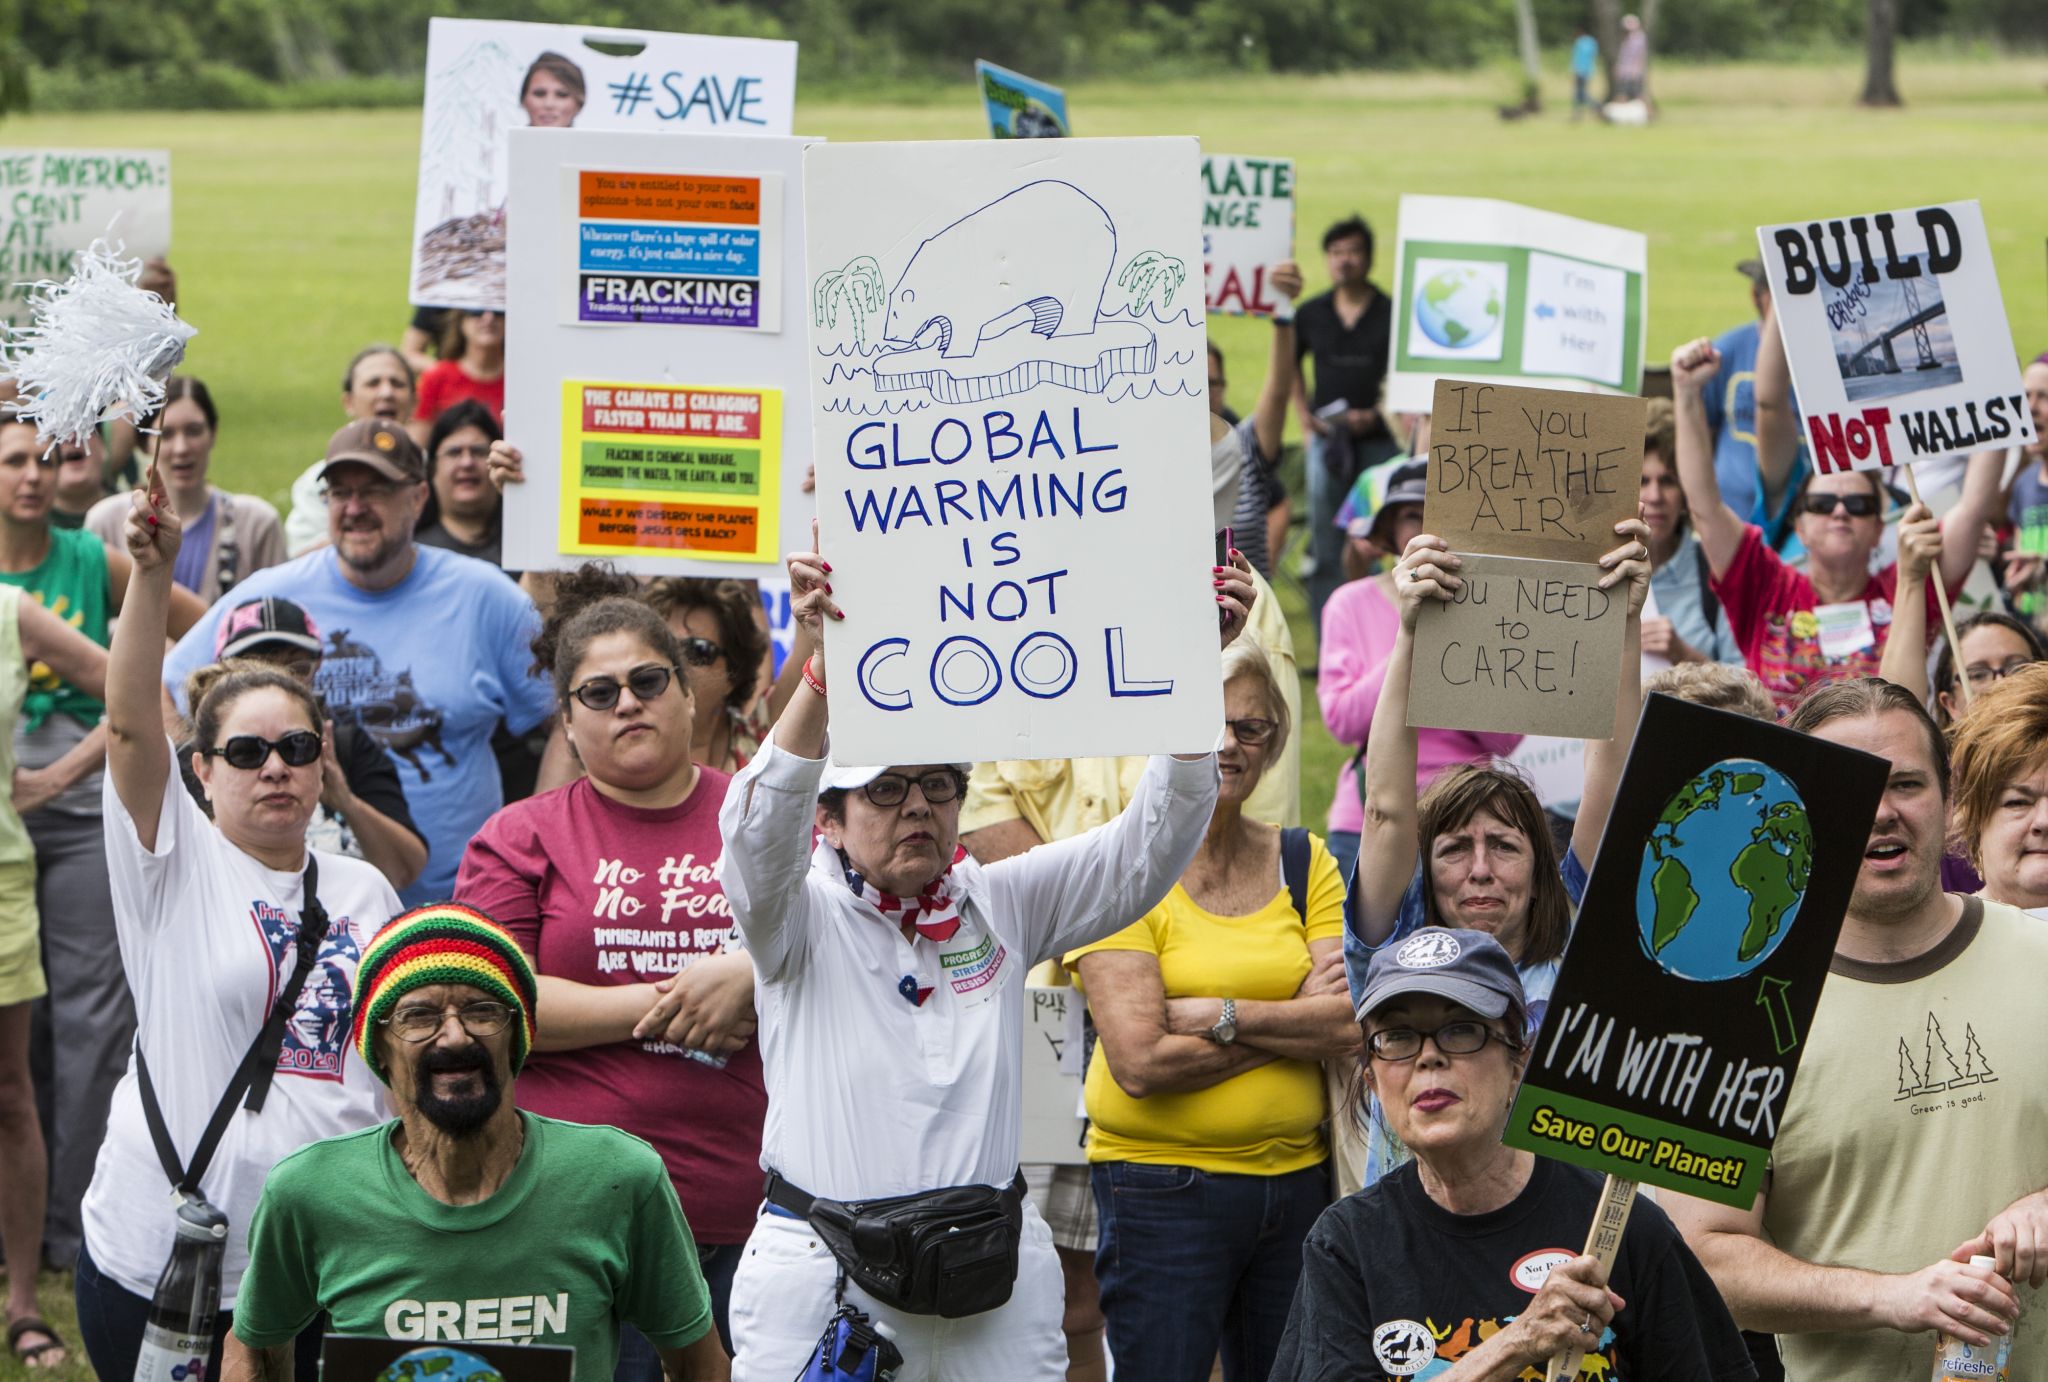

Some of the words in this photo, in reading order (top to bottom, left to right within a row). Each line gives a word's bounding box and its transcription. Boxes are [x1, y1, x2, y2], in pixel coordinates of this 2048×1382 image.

[608, 71, 767, 125] #SAVE
[596, 177, 616, 190] You
[619, 179, 636, 190] are
[640, 179, 679, 192] entitled
[683, 181, 695, 192] to
[697, 183, 721, 195] your
[725, 184, 747, 194] own
[656, 197, 673, 208] not
[676, 199, 701, 211] your
[704, 200, 726, 210] own
[730, 199, 756, 211] facts
[582, 226, 629, 243] Whenever
[631, 229, 663, 244] there's
[664, 234, 671, 244] a
[699, 232, 718, 247] spill
[719, 233, 731, 246] of
[732, 235, 756, 247] solar
[1775, 207, 1962, 294] BUILD
[628, 246, 643, 259] it's
[643, 247, 663, 261] just
[664, 247, 693, 261] called
[694, 251, 701, 261] a
[703, 250, 723, 262] nice
[587, 277, 753, 307] FRACKING
[588, 302, 628, 315] Trading
[629, 303, 659, 314] clean
[661, 304, 691, 315] water
[693, 305, 709, 316] for
[711, 306, 735, 319] dirty
[737, 307, 751, 318] oil
[1562, 305, 1607, 325] with
[1561, 331, 1597, 352] Her
[584, 389, 612, 406] THE
[615, 390, 670, 409] CLIMATE
[673, 392, 687, 410] IS
[689, 394, 759, 414] CHANGING
[594, 409, 645, 427] FASTER
[648, 411, 686, 429] THAN
[689, 413, 713, 430] WE
[715, 414, 748, 432] ARE.
[1808, 407, 1894, 474] NOT
[1900, 395, 2029, 455] WALLS!
[847, 407, 1119, 470] GLOBAL
[605, 447, 644, 462] FRACKING
[646, 450, 654, 463] IS
[656, 450, 695, 465] CHEMICAL
[1433, 444, 1626, 498] BREATHE
[584, 464, 624, 479] POISONING
[626, 466, 641, 480] THE
[674, 468, 688, 482] THE
[721, 471, 737, 484] AND
[844, 468, 1128, 534] WARMING
[1471, 493, 1586, 540] AIR,
[963, 532, 1021, 568] IS
[940, 569, 1068, 622] NOT
[1443, 577, 1488, 612] OU
[1516, 578, 1610, 621] NEED
[1495, 616, 1530, 640] to
[857, 627, 1175, 712] COOL
[1441, 640, 1579, 696] CARE!
[593, 858, 646, 886] No
[657, 854, 723, 888] Hat
[593, 886, 646, 920] No
[660, 886, 733, 924] Fea
[594, 927, 676, 948] IMMIGRANTS
[679, 930, 690, 948] &
[693, 928, 728, 950] REFU
[598, 950, 628, 974] ARE
[952, 946, 996, 978] STRENGTH
[954, 948, 1005, 992] RESISTANCE
[1544, 1003, 1616, 1084] I'M
[1616, 1027, 1712, 1117] WITH
[1708, 1057, 1785, 1138] HER
[1911, 1104, 1942, 1115] Green
[1961, 1091, 1986, 1109] good.
[1531, 1108, 1595, 1146] Save
[1601, 1127, 1650, 1160] Our
[1653, 1140, 1743, 1185] Planet!
[1525, 1264, 1543, 1275] Not
[384, 1293, 569, 1342] GREEN
[1943, 1357, 1994, 1374] refreshe
